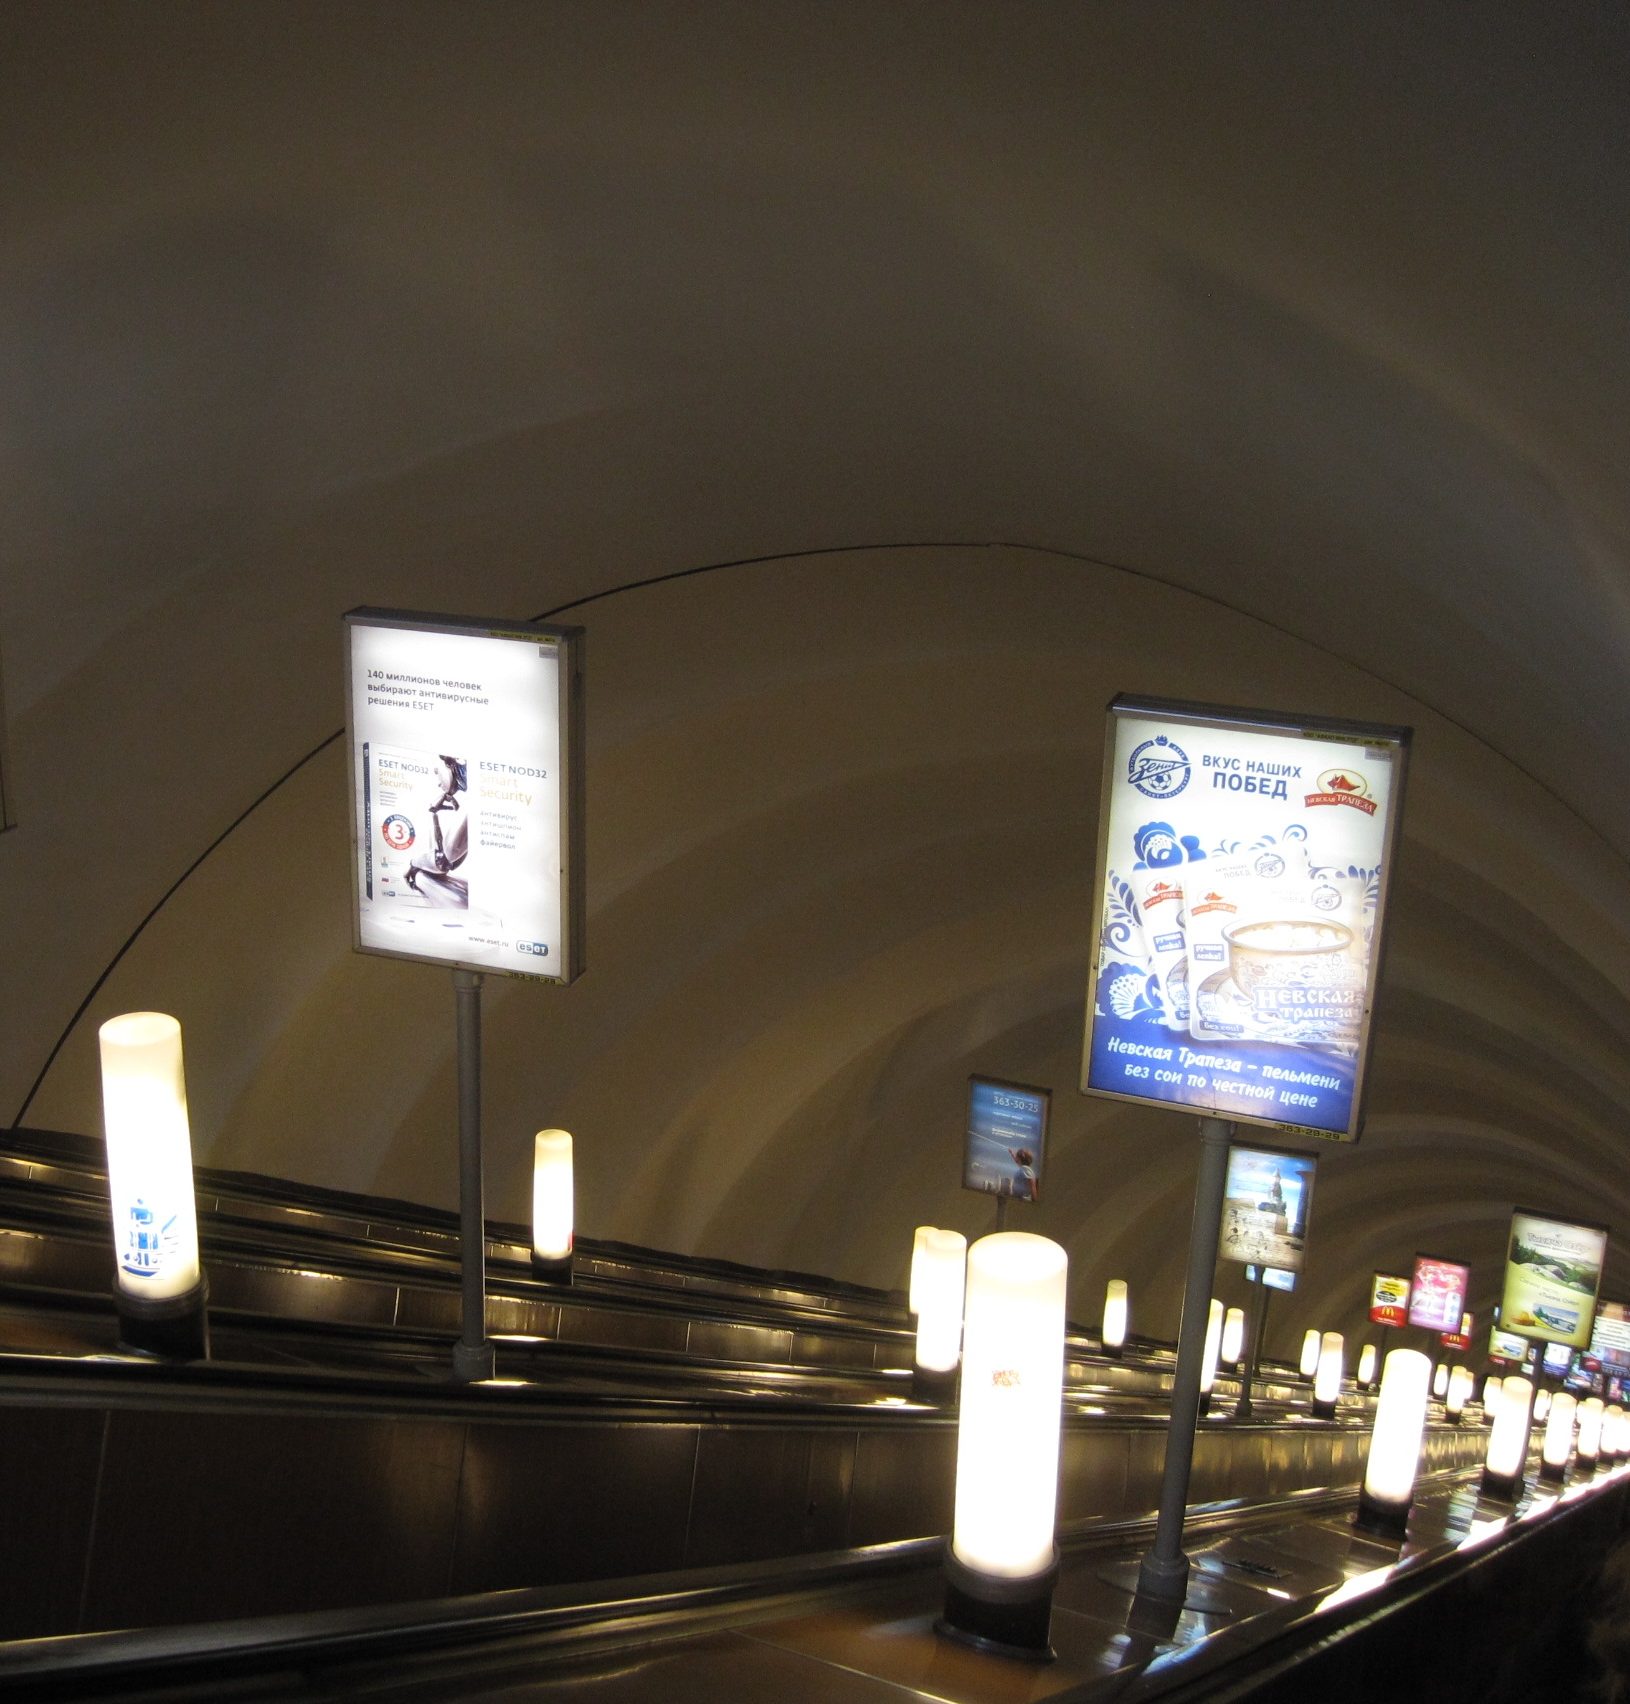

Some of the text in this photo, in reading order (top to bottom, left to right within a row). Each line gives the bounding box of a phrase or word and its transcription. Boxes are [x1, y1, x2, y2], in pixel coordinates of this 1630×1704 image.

[367, 668, 483, 692] 140 миллионов человек
[367, 683, 489, 706] выбирают антивирусные
[367, 696, 435, 711] решения ESET
[379, 759, 430, 775] ESET NOD32
[480, 761, 548, 779] ESET NOD32
[1202, 755, 1302, 779] ВКУС НАШИХ
[480, 773, 519, 788] Smart
[1213, 771, 1288, 801] ПОБЕД
[480, 788, 533, 807] Security
[395, 823, 404, 840] 3
[1107, 1036, 1173, 1062] Невская
[1179, 1047, 1242, 1073] Трапеза
[1262, 1064, 1341, 1090] пельмени
[1154, 1070, 1181, 1085] сои
[1187, 1075, 1206, 1089] по
[1213, 1077, 1275, 1101] честной
[1279, 1091, 1319, 1108] цене
[1279, 1123, 1340, 1139] 363-29-29
